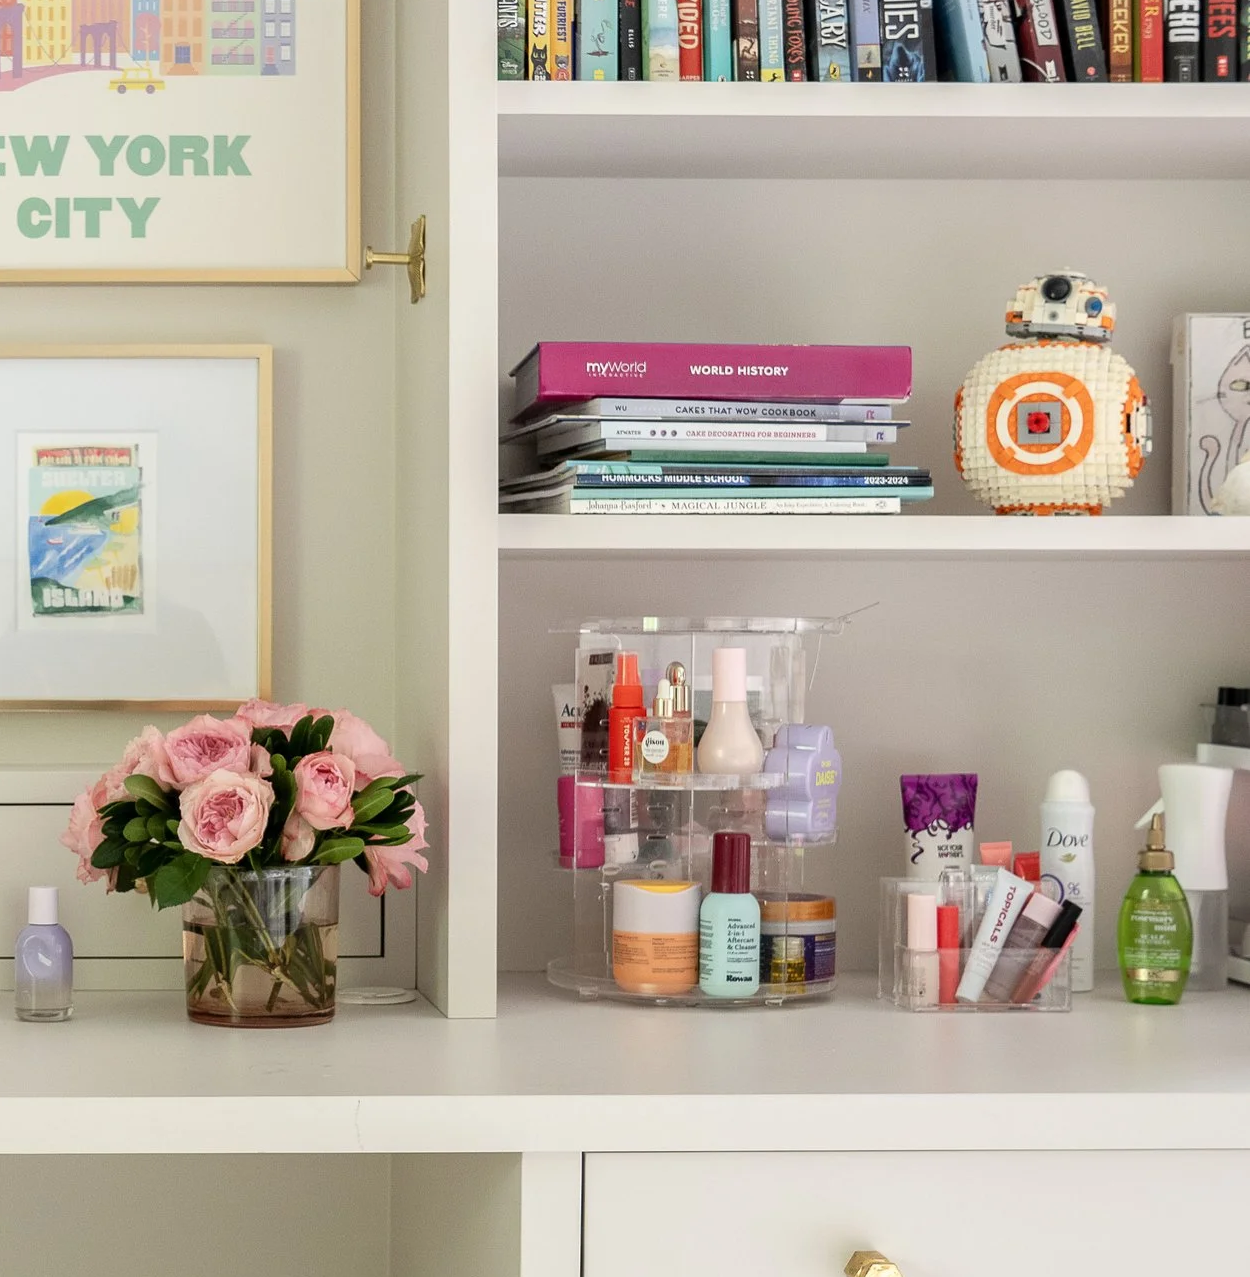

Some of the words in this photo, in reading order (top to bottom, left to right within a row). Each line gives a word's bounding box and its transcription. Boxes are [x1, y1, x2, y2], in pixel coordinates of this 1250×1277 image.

[556, 1, 567, 43] FURRIEST
[787, 29, 805, 64] FOXES
[1075, 24, 1096, 51] BELL
[768, 35, 780, 64] THING
[83, 134, 253, 177] YORK
[15, 196, 162, 240] CITY
[586, 361, 647, 376] myWorld
[689, 365, 734, 377] WORLD
[736, 365, 789, 377] HISTORY
[675, 406, 706, 415] CAKES
[707, 407, 733, 415] THAT
[735, 407, 758, 416] WOW
[761, 408, 817, 418] COOKBOOK
[685, 430, 707, 438] CAKE
[707, 430, 756, 438] DECORATING
[756, 431, 772, 439] FOR
[773, 431, 817, 439] BEGINNERS
[42, 470, 127, 488] SHELTER
[664, 474, 702, 483] MIDDLE
[703, 474, 746, 484] SCHOOL
[863, 476, 909, 485] 2023-2024
[586, 500, 619, 511] Johanna
[619, 500, 652, 511] Basford
[671, 501, 721, 510] MAGICAL
[723, 501, 767, 511] JUNGLE
[42, 587, 124, 608] ISLAND
[1046, 827, 1089, 848] Dove
[989, 884, 1017, 945] TOPICALS
[726, 922, 756, 930] Advanced
[726, 974, 753, 983] Rowan
